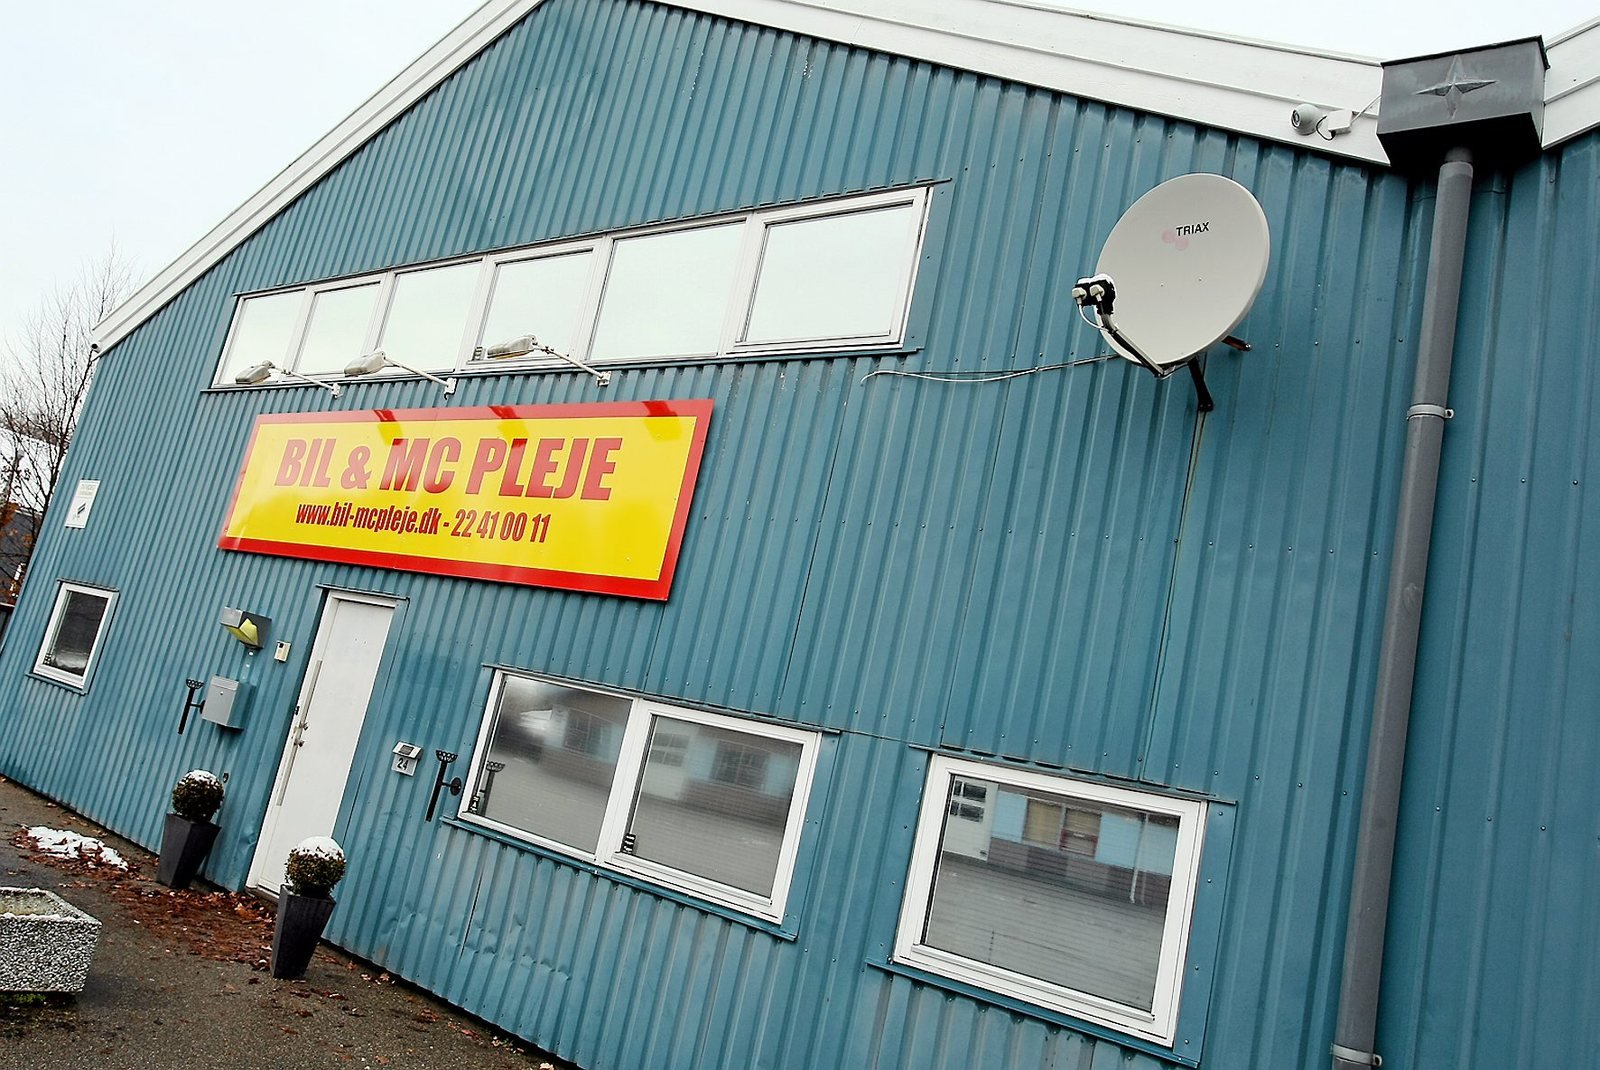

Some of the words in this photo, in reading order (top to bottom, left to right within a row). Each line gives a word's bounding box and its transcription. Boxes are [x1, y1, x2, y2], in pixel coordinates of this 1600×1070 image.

[1176, 222, 1209, 236] TRIAX
[274, 438, 336, 487] BIL
[341, 445, 372, 489] &
[379, 437, 462, 493] MC
[465, 438, 623, 500] PLEJE
[296, 502, 442, 534] www.bil-mcpleje.dk
[450, 509, 477, 537] 22
[476, 511, 500, 539] 41
[500, 511, 528, 541] 00
[530, 513, 551, 543] 11
[397, 757, 408, 770] 24
